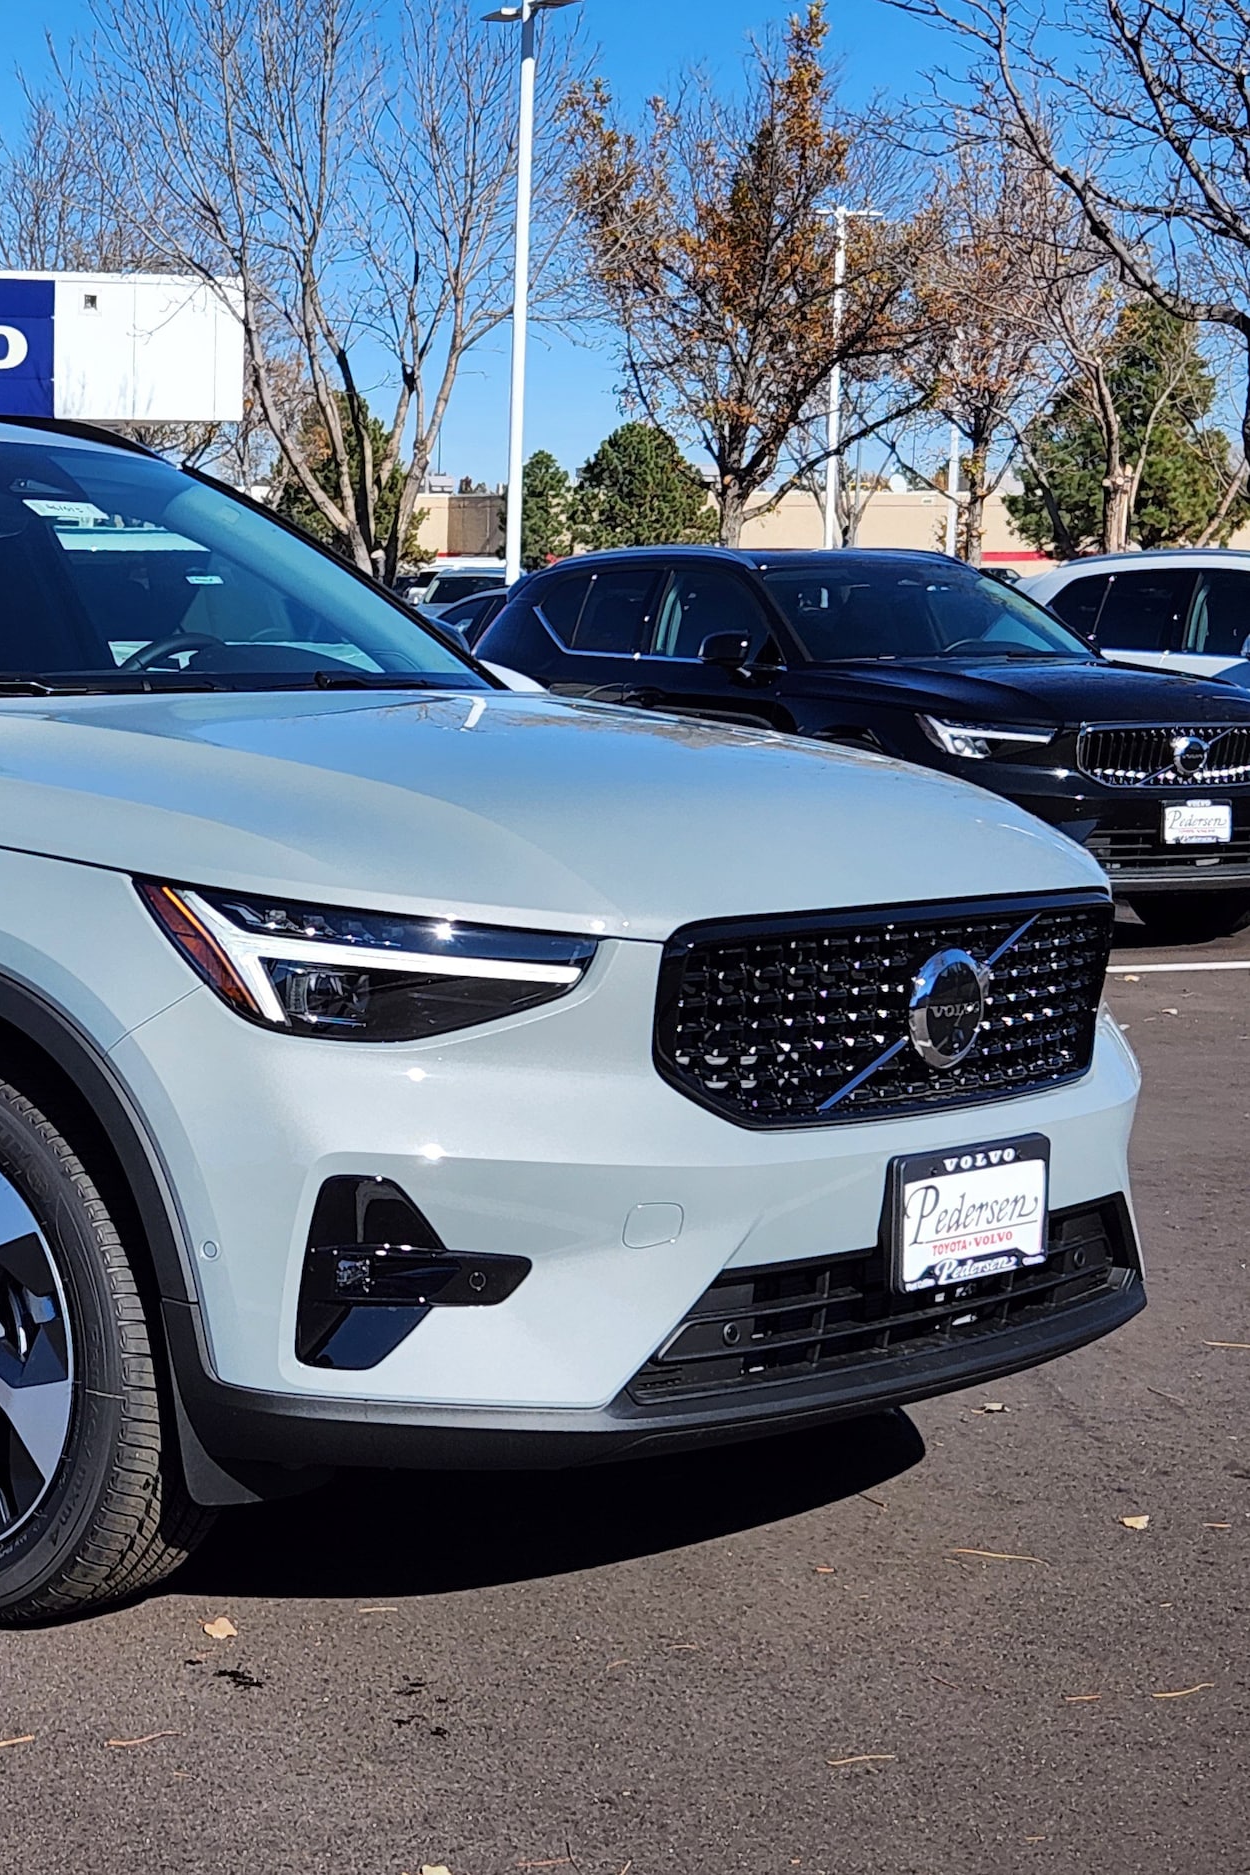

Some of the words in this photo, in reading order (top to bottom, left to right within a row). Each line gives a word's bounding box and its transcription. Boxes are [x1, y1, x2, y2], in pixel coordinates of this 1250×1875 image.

[943, 1148, 1016, 1172] VOLVO
[904, 1184, 1039, 1247] Pedersen
[932, 1239, 967, 1257] TOYOTA
[973, 1231, 1013, 1247] VOLVO
[934, 1256, 1018, 1284] Pedersen
